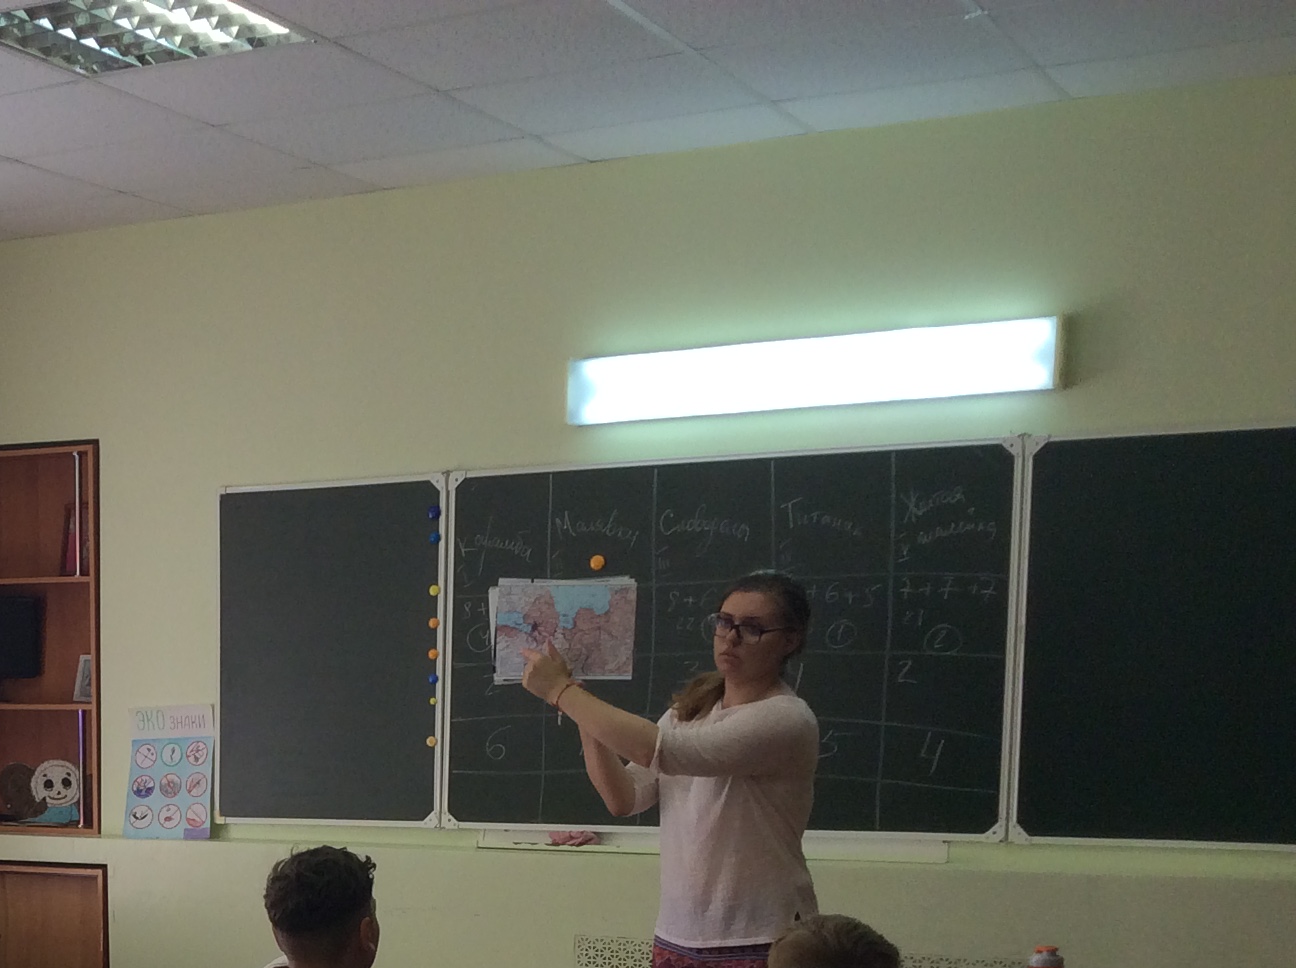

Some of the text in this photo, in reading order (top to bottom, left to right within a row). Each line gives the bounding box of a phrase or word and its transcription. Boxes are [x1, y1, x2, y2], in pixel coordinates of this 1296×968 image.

[135, 709, 207, 731] ЭКО ЗНАКИ
[485, 725, 512, 761] 6
